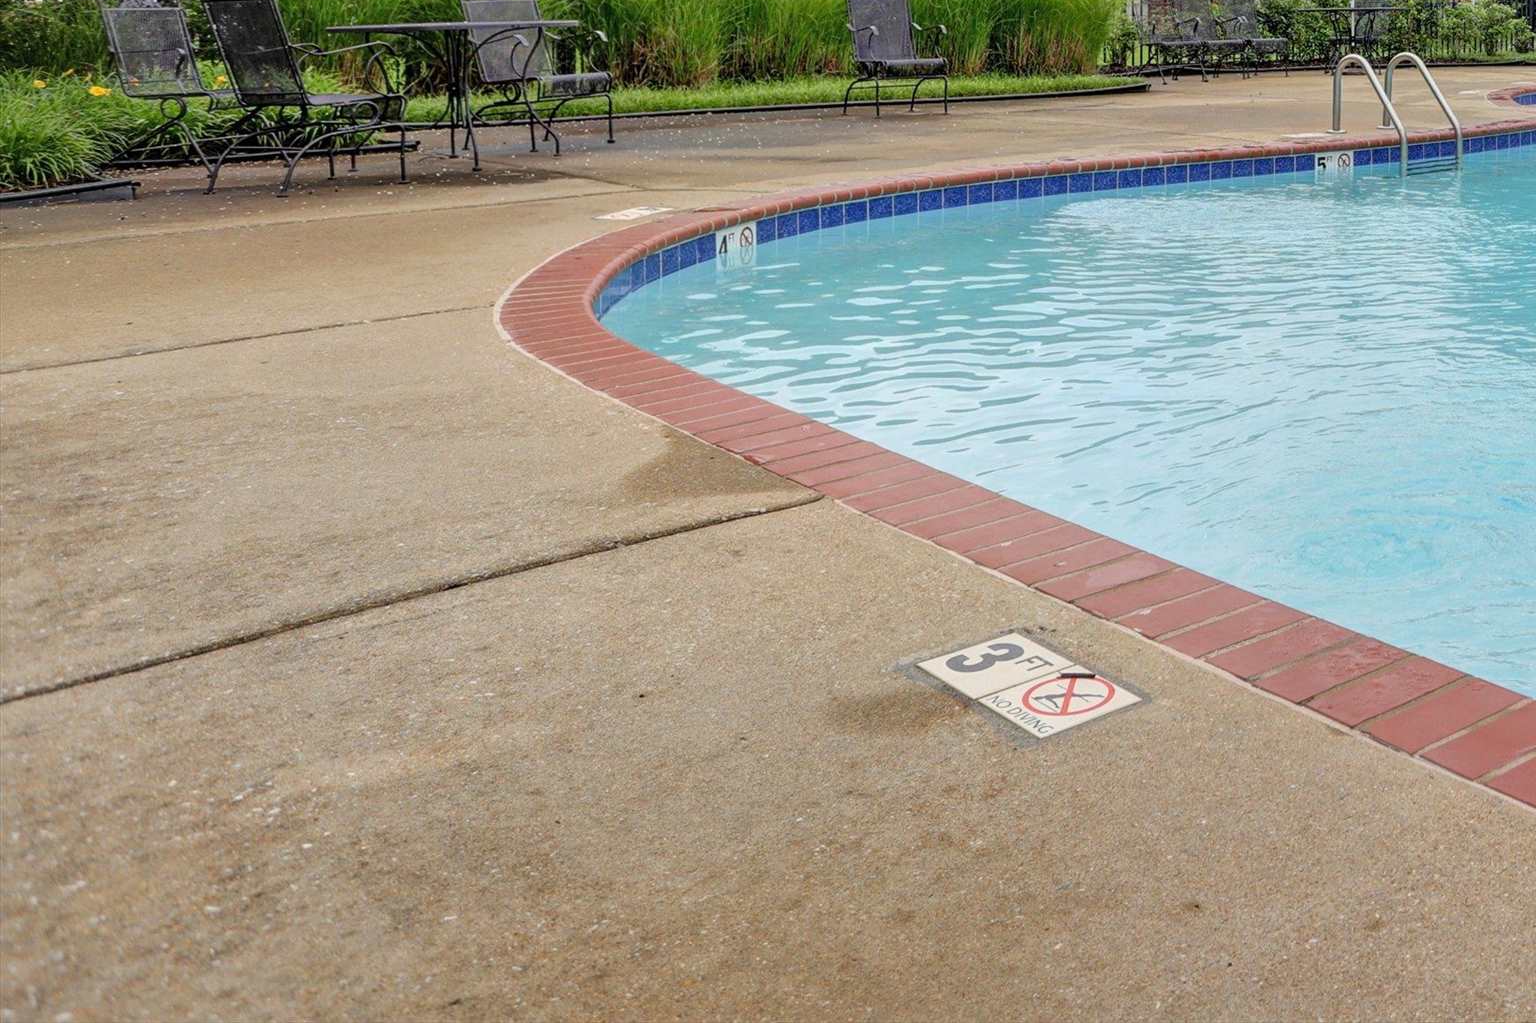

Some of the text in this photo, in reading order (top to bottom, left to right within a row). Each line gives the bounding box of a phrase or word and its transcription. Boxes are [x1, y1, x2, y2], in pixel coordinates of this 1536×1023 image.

[1318, 157, 1326, 169] 5
[719, 235, 727, 254] 4
[946, 643, 1054, 673] 3 FT
[990, 695, 1054, 734] NO DIVING
